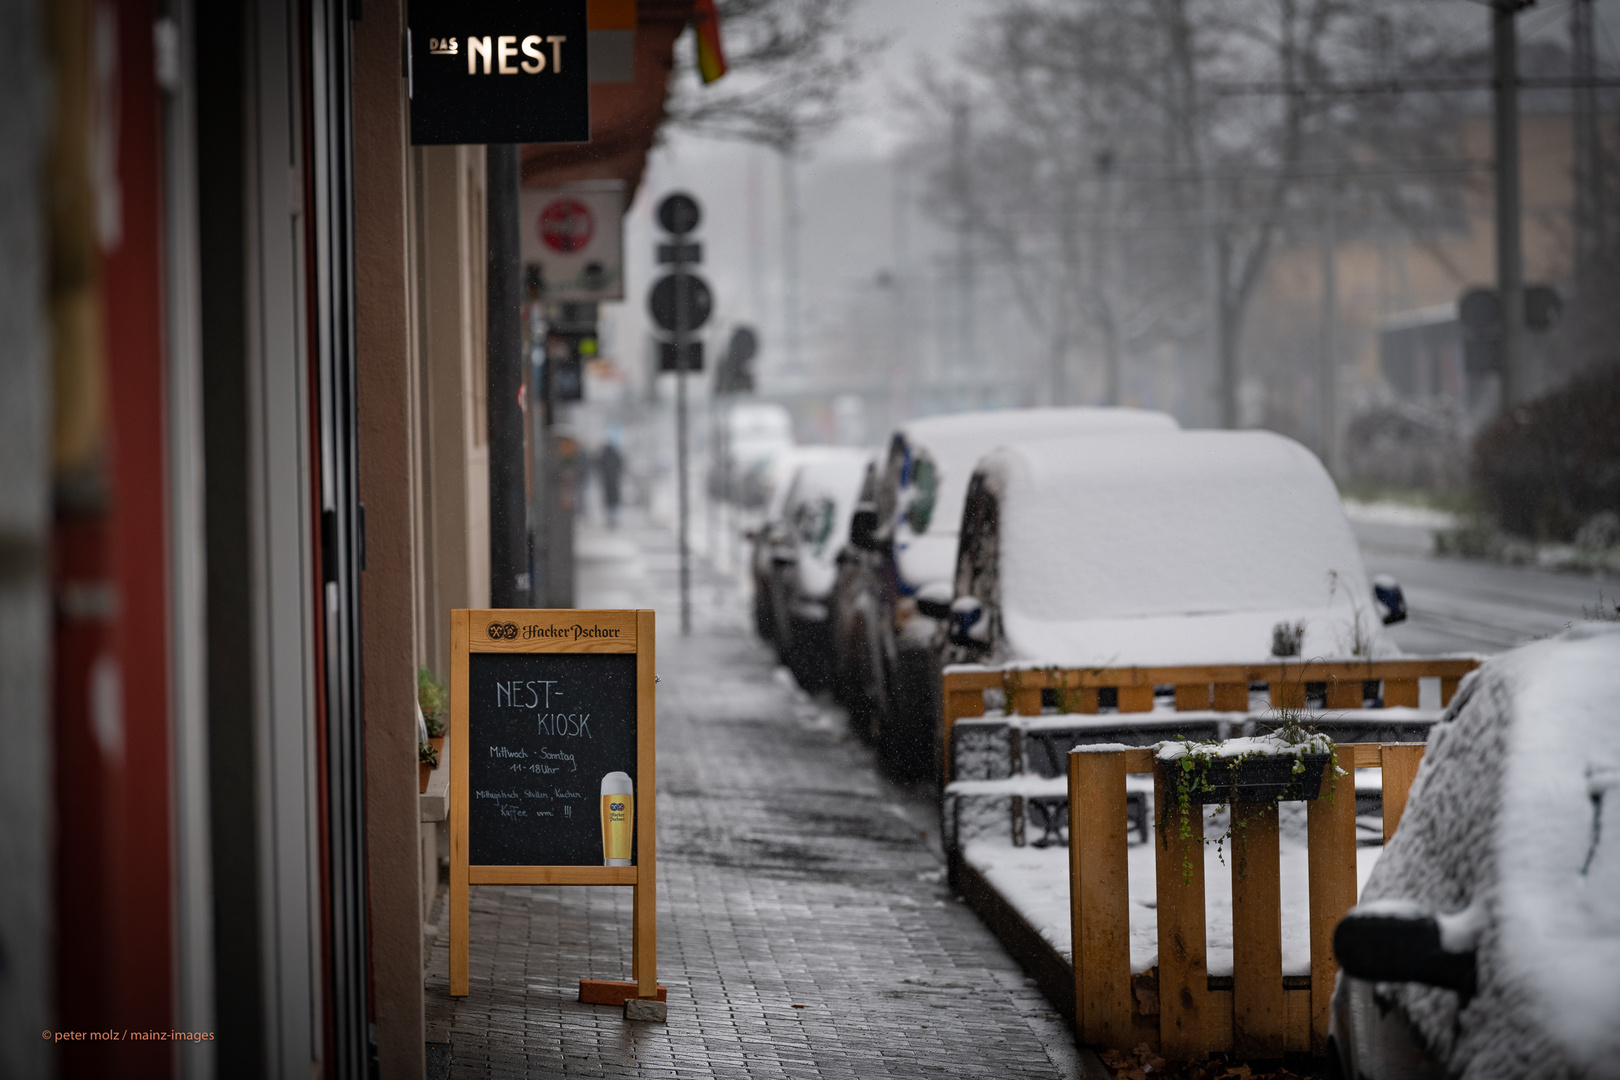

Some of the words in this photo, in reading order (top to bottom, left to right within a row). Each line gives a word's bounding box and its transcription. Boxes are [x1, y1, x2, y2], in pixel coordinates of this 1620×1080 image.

[429, 37, 458, 54] DAS
[467, 34, 567, 75] NEST
[496, 680, 563, 709] NEST-
[537, 713, 592, 739] KIOSK
[489, 746, 528, 759] Mittwoch
[539, 747, 577, 773] Sonntag
[500, 804, 528, 821] Kaffee
